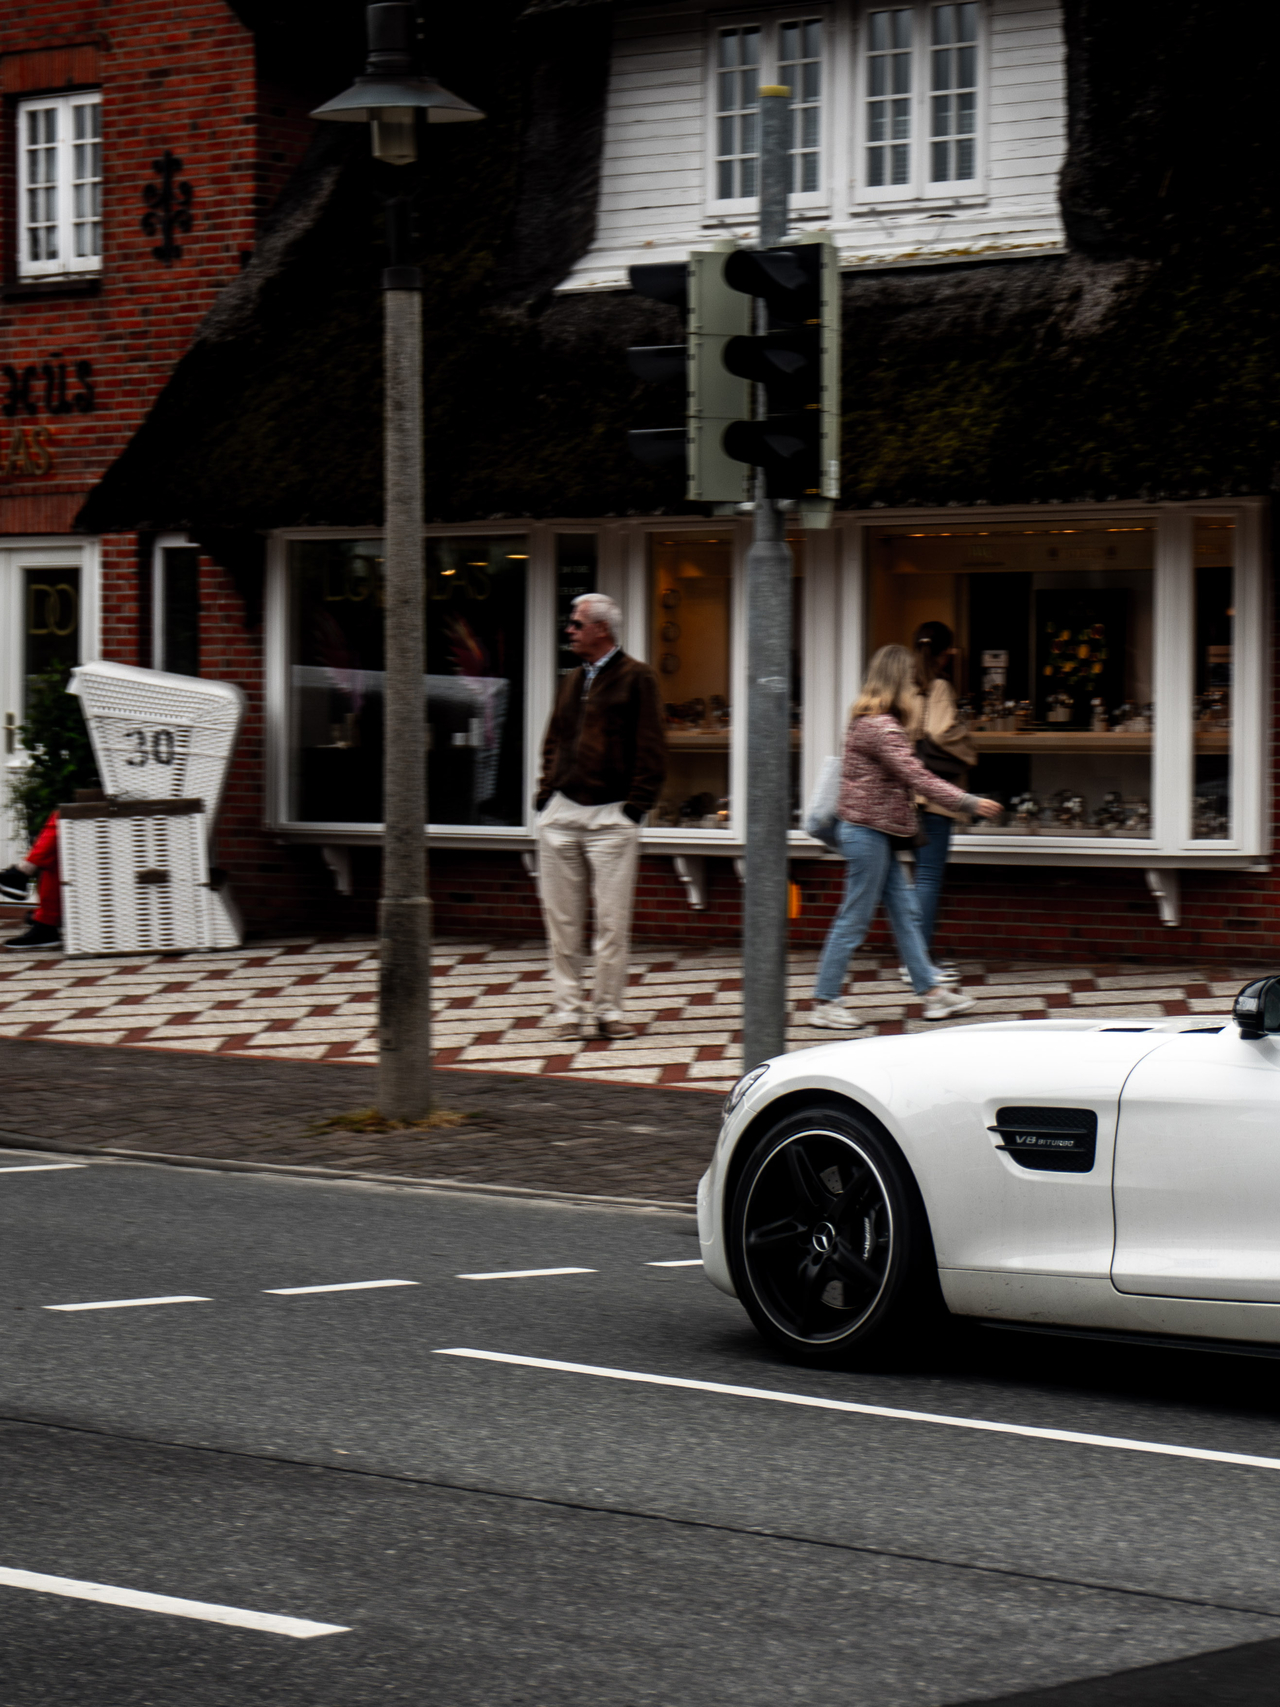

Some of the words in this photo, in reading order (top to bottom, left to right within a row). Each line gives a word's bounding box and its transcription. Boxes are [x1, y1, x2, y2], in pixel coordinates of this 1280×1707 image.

[0, 425, 49, 475] AS
[125, 729, 175, 767] 30
[1015, 1135, 1037, 1145] V8
[1037, 1139, 1075, 1147] BITURBO
